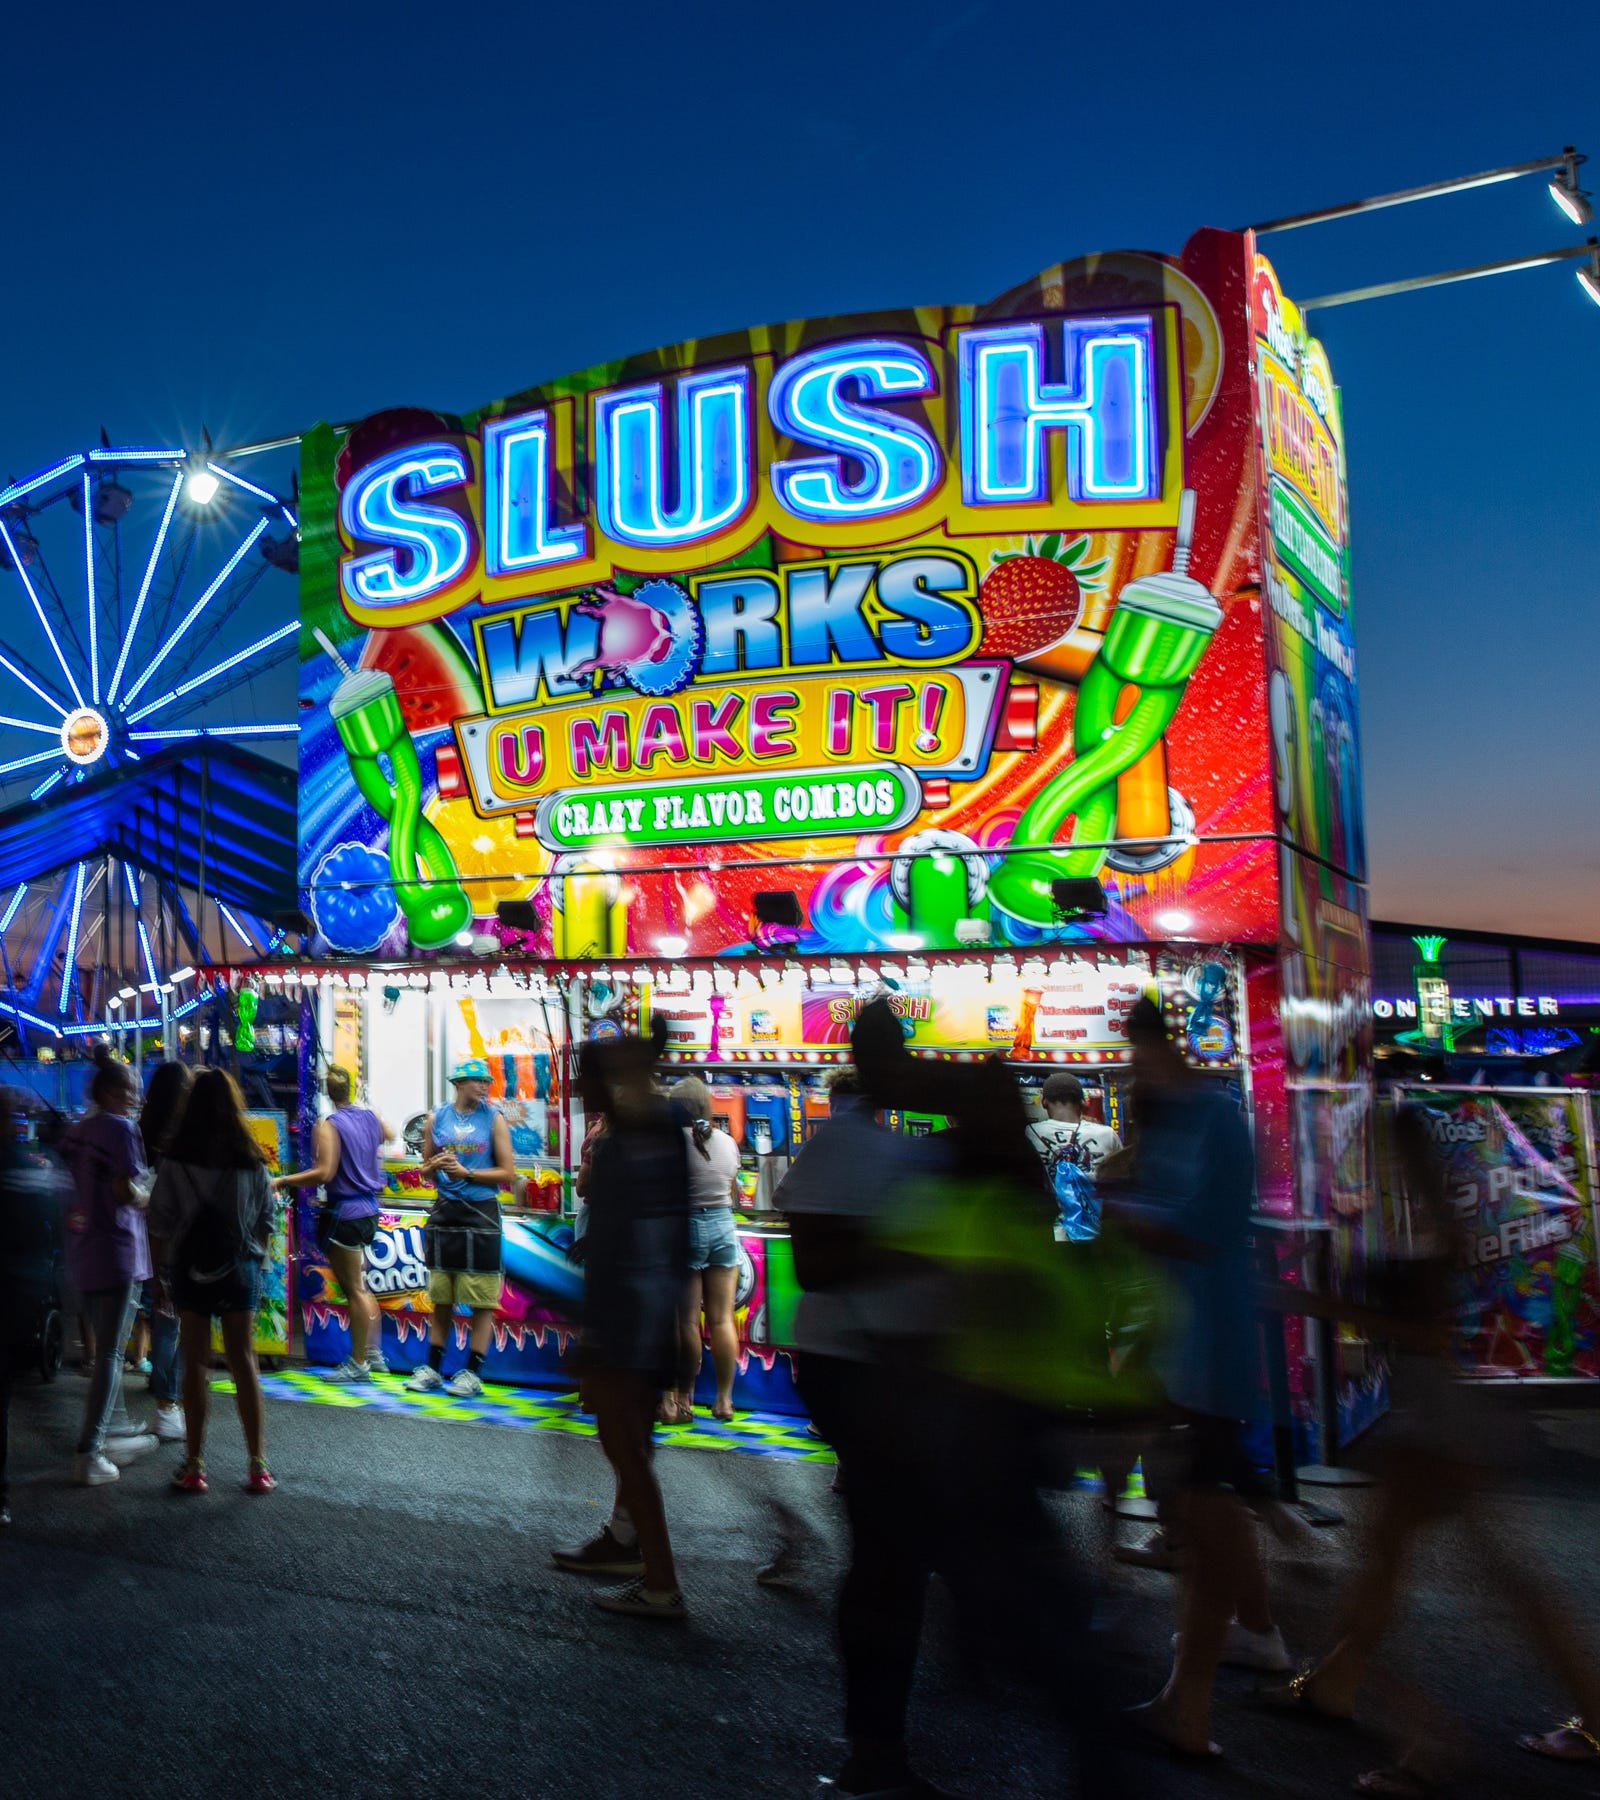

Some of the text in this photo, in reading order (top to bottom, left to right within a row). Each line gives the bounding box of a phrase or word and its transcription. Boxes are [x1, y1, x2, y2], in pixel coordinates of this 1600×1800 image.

[340, 314, 1166, 607] SLUSH
[483, 555, 971, 704] WORKS
[499, 681, 946, 784] U MAKE IT!
[556, 778, 894, 837] CRAZY FLAVOR COMBOS
[831, 994, 931, 1020] SLSH
[1373, 999, 1417, 1018] ON
[1431, 996, 1559, 1018] CENTER
[666, 1029, 696, 1042] arge
[1109, 1086, 1120, 1134] PRIC
[362, 1226, 426, 1270] OLL
[361, 1262, 431, 1293] ranch
